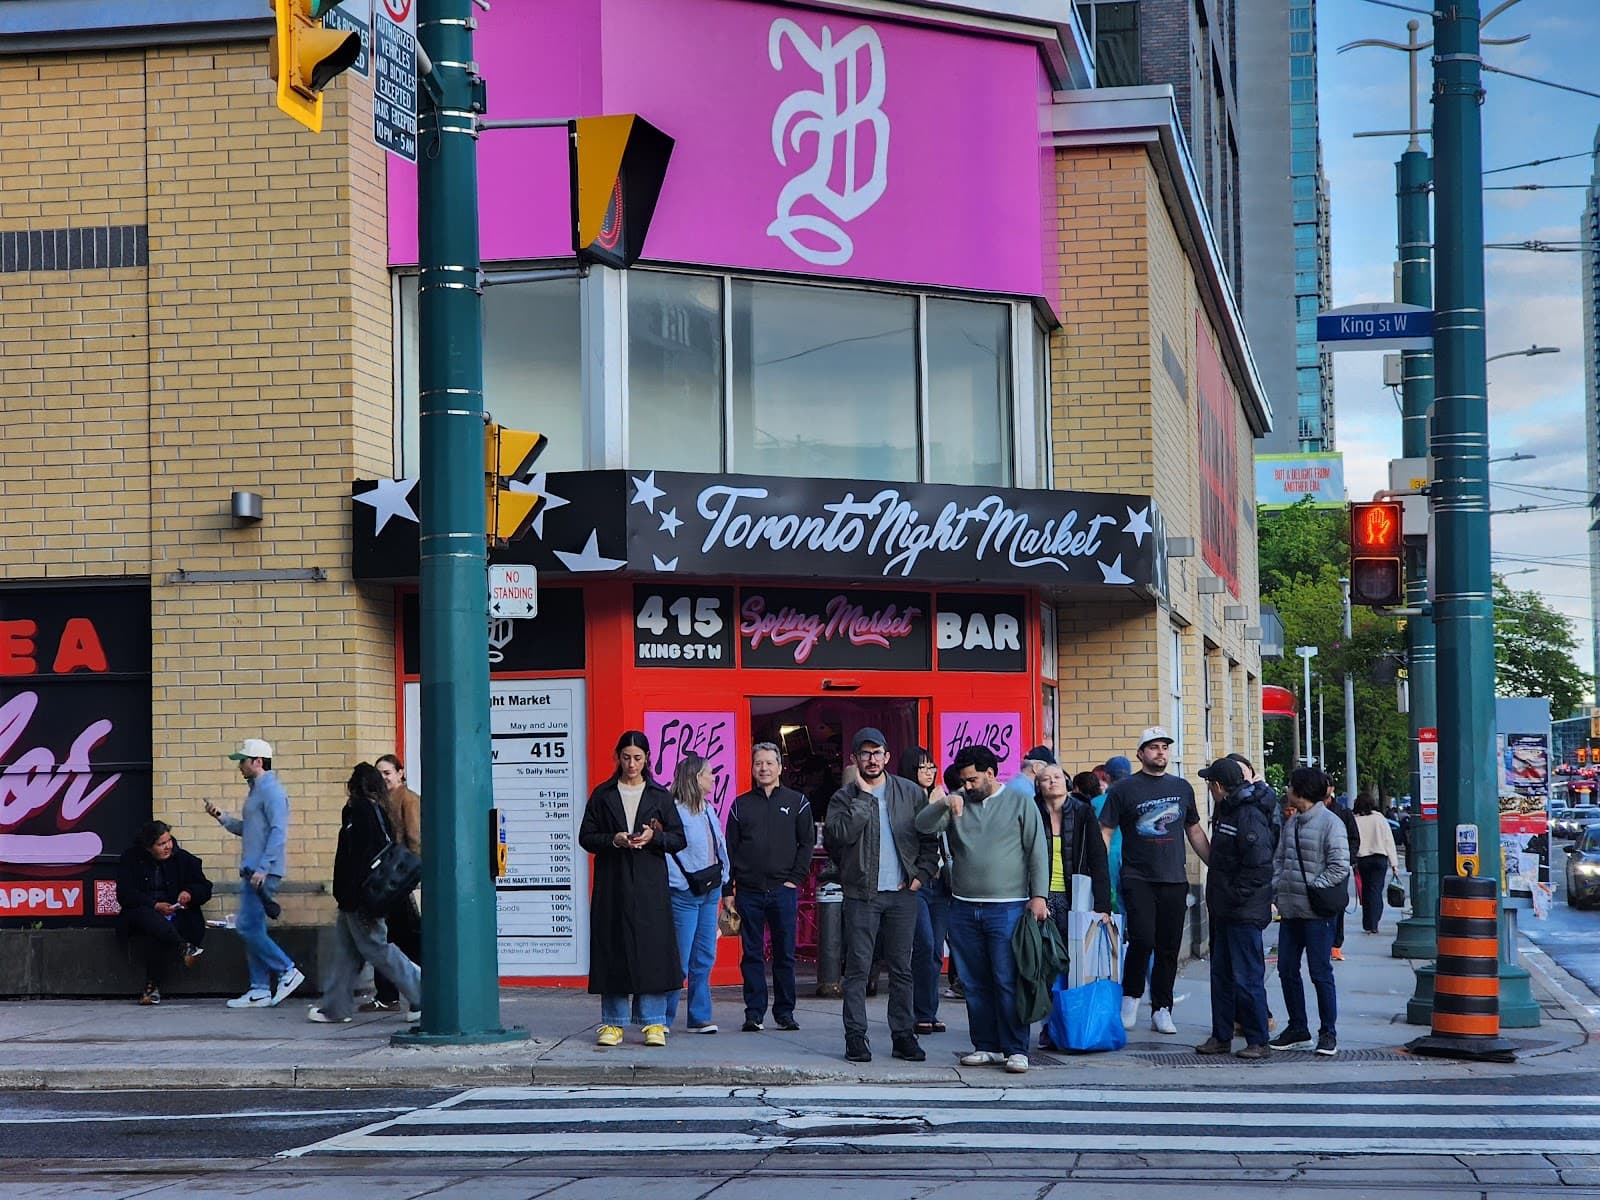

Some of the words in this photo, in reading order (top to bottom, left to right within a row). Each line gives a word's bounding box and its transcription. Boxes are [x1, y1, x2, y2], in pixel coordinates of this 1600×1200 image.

[377, 16, 414, 52] AUTHORIZED
[381, 37, 410, 69] VEHICLES
[376, 54, 388, 76] AND
[390, 62, 415, 91] BICYCLES
[380, 77, 411, 109] EXCEPTED
[375, 98, 389, 121] TAXIS
[392, 107, 416, 135] EXCEPTED
[1341, 317, 1374, 337] King
[1378, 319, 1391, 332] St
[1394, 315, 1407, 331] W
[697, 485, 868, 552] Toronto
[867, 489, 972, 576] Night
[973, 496, 1117, 572] Market
[505, 571, 519, 583] NO
[493, 587, 533, 599] STANDING
[637, 595, 723, 637] 415
[741, 595, 826, 664] Spring
[825, 595, 921, 649] Market
[936, 612, 1021, 651] BAR
[639, 643, 681, 659] KING
[683, 644, 706, 660] ST
[707, 644, 721, 660] W
[508, 694, 551, 706] Market
[510, 722, 527, 731] May
[530, 722, 545, 730] and
[530, 742, 565, 758] 415
[654, 719, 726, 775] FREE
[525, 768, 543, 776] Daily
[540, 791, 569, 799] 6-11pm
[540, 801, 569, 809] 5-11pm
[545, 812, 569, 820] 3-8pm
[550, 843, 571, 851] 100%
